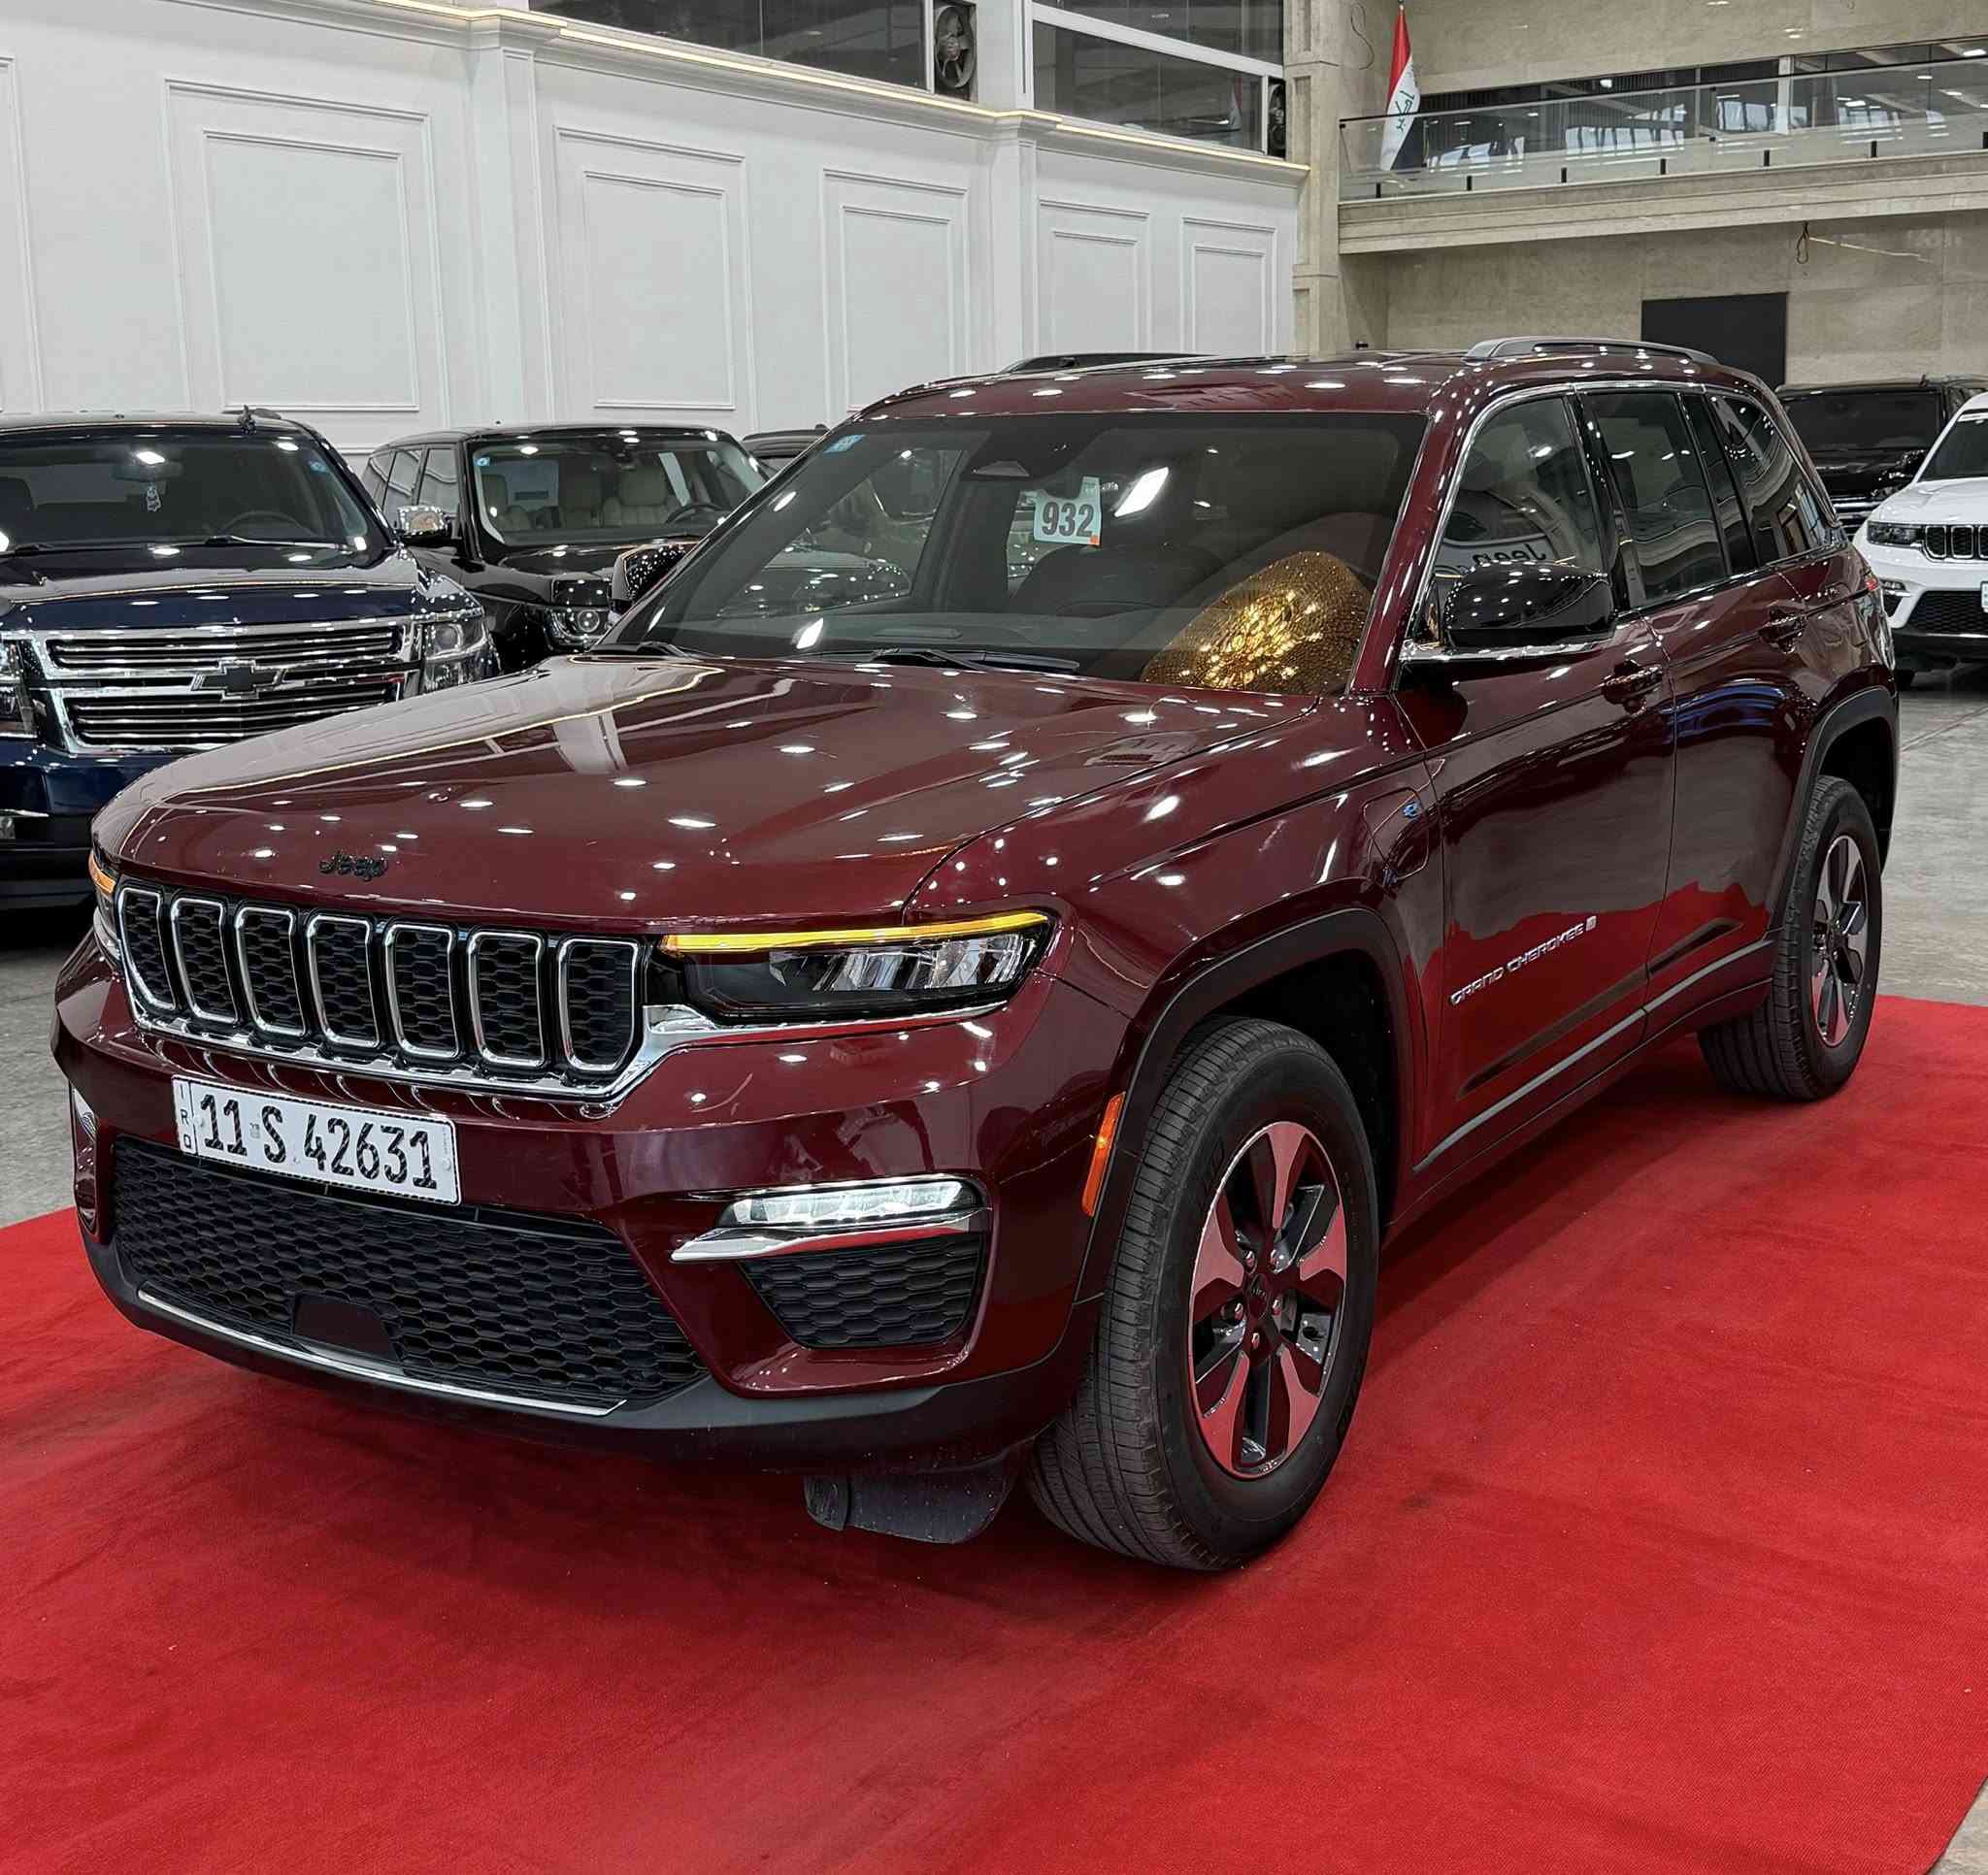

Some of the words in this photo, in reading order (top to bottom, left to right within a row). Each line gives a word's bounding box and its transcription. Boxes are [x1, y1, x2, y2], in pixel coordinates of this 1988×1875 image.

[1042, 501, 1095, 537] 932
[319, 850, 388, 881] Jeep
[1450, 967, 1505, 1005] GRAND
[1507, 923, 1584, 971] CHEROKEE
[200, 1094, 248, 1157] 11
[261, 1104, 287, 1164] S
[304, 1113, 437, 1190] 42631
